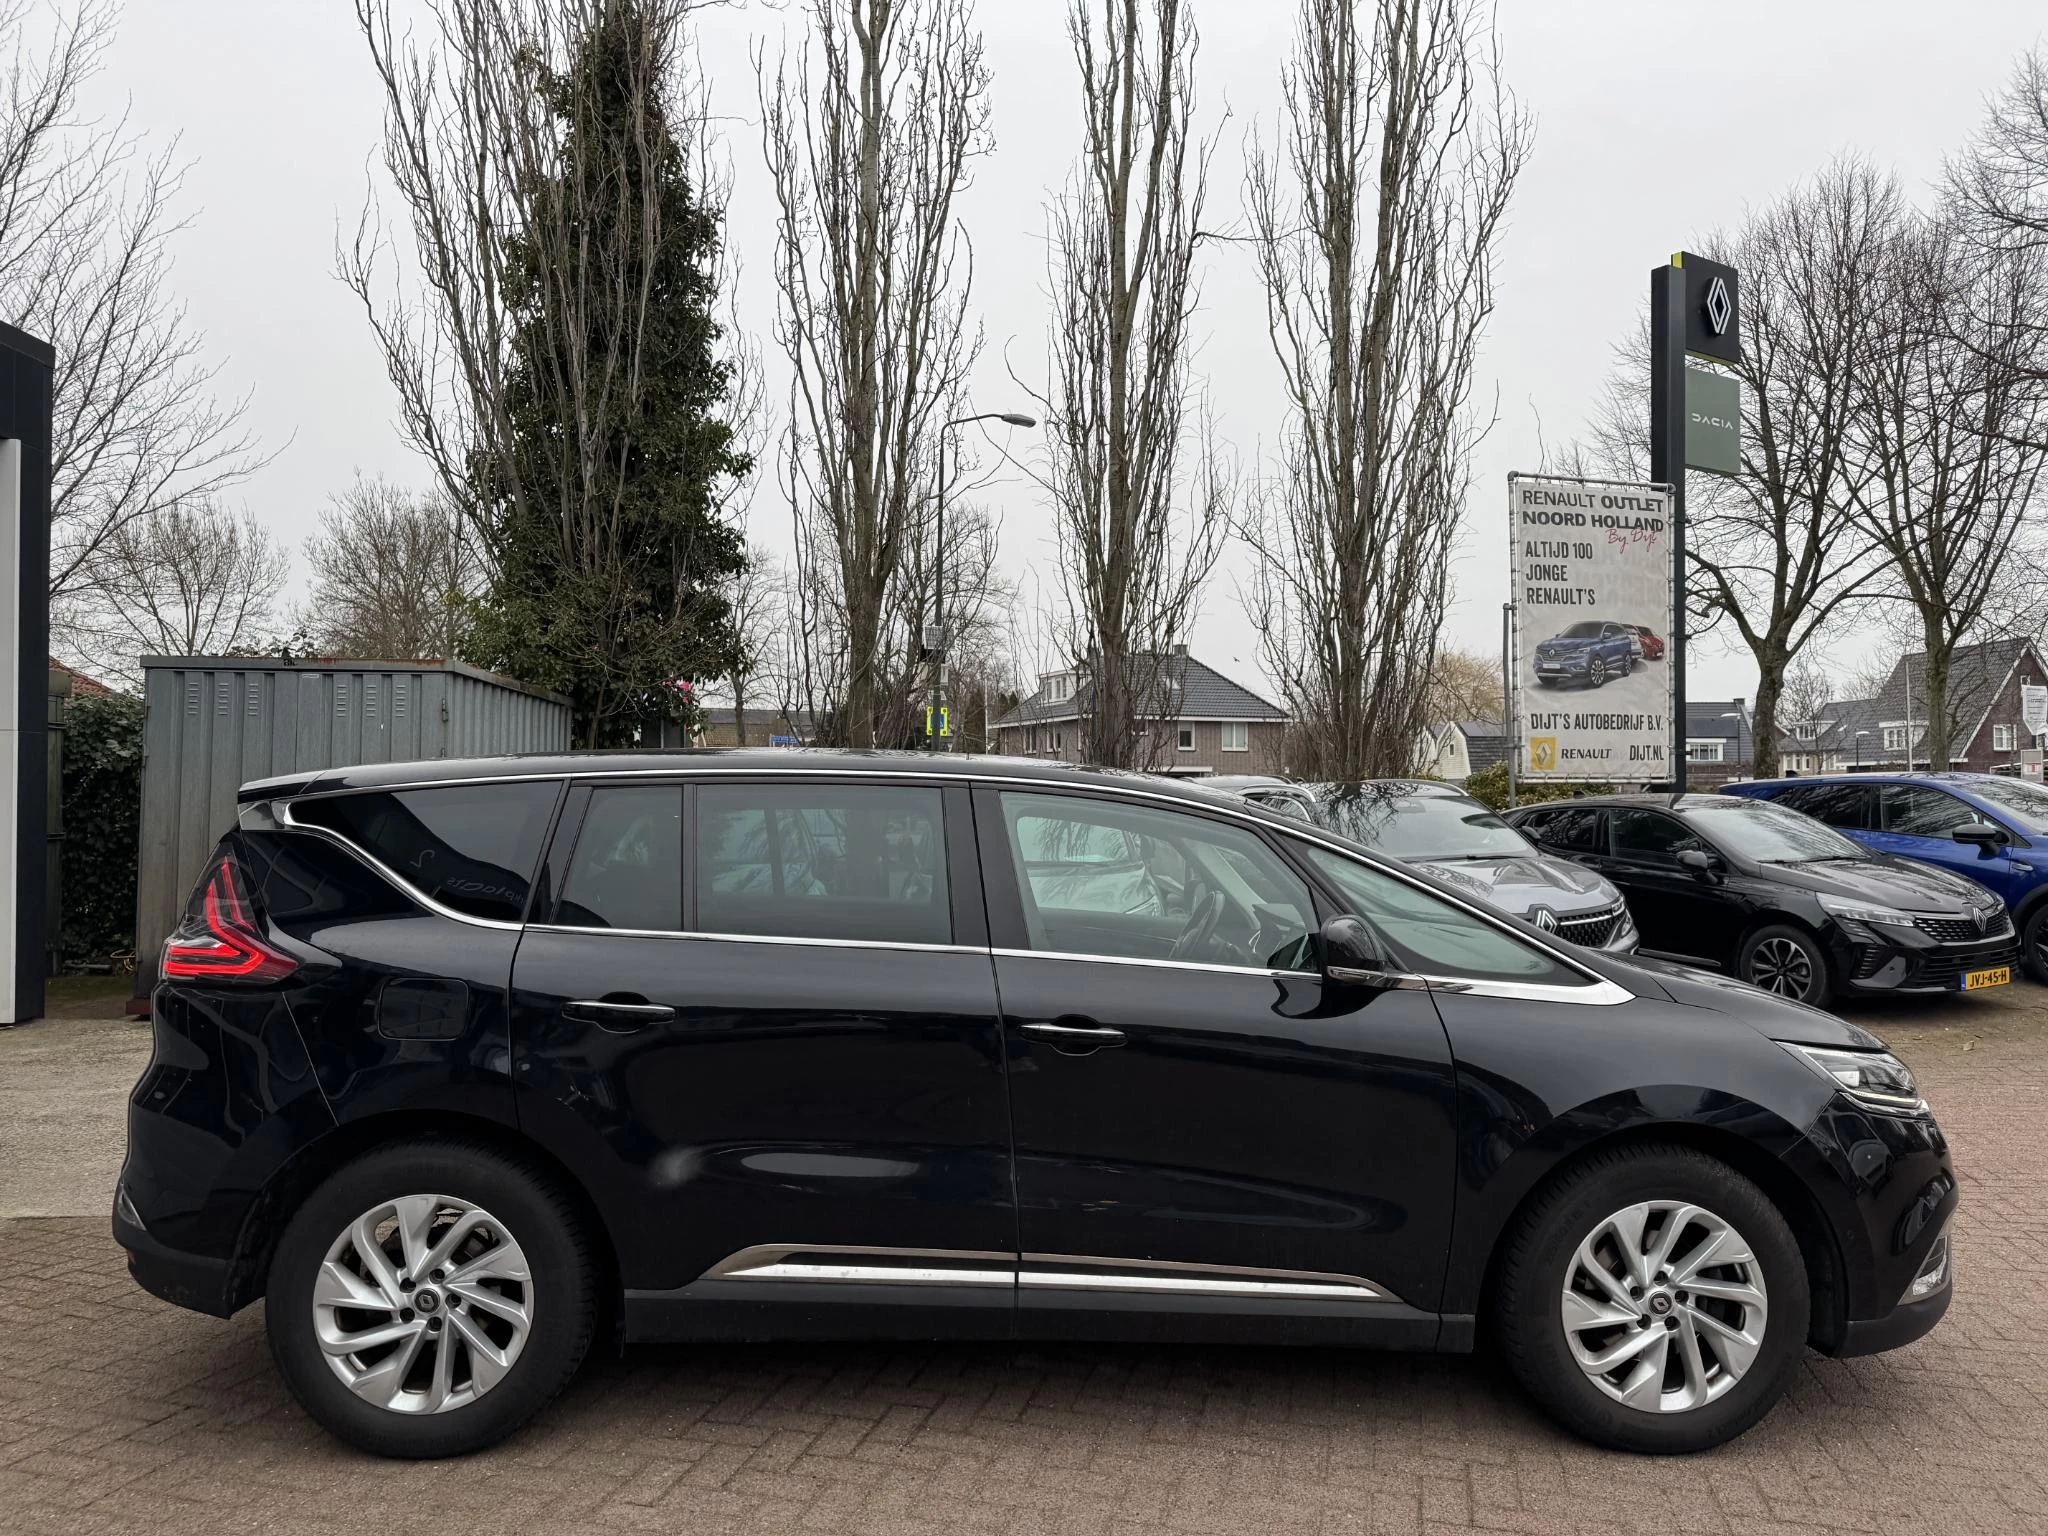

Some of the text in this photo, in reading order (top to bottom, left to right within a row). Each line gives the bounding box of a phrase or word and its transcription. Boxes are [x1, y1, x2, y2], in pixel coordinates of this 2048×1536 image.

[1691, 413, 1733, 429] DACIA
[1522, 490, 1664, 513] RENAULT OUTLET
[1522, 511, 1664, 532] NOORD HOLLAND
[1525, 541, 1593, 559] ALTIJD 100
[1606, 528, 1628, 554] By
[1525, 564, 1568, 581] JONGE
[1526, 587, 1595, 605] RENAULT'S
[1530, 713, 1664, 731] DIJT'S AUTOBEDRIJF B.V.
[1561, 745, 1664, 761] RENAULT DIJT.NL
[1969, 969, 2007, 987] JVJ-45-H
